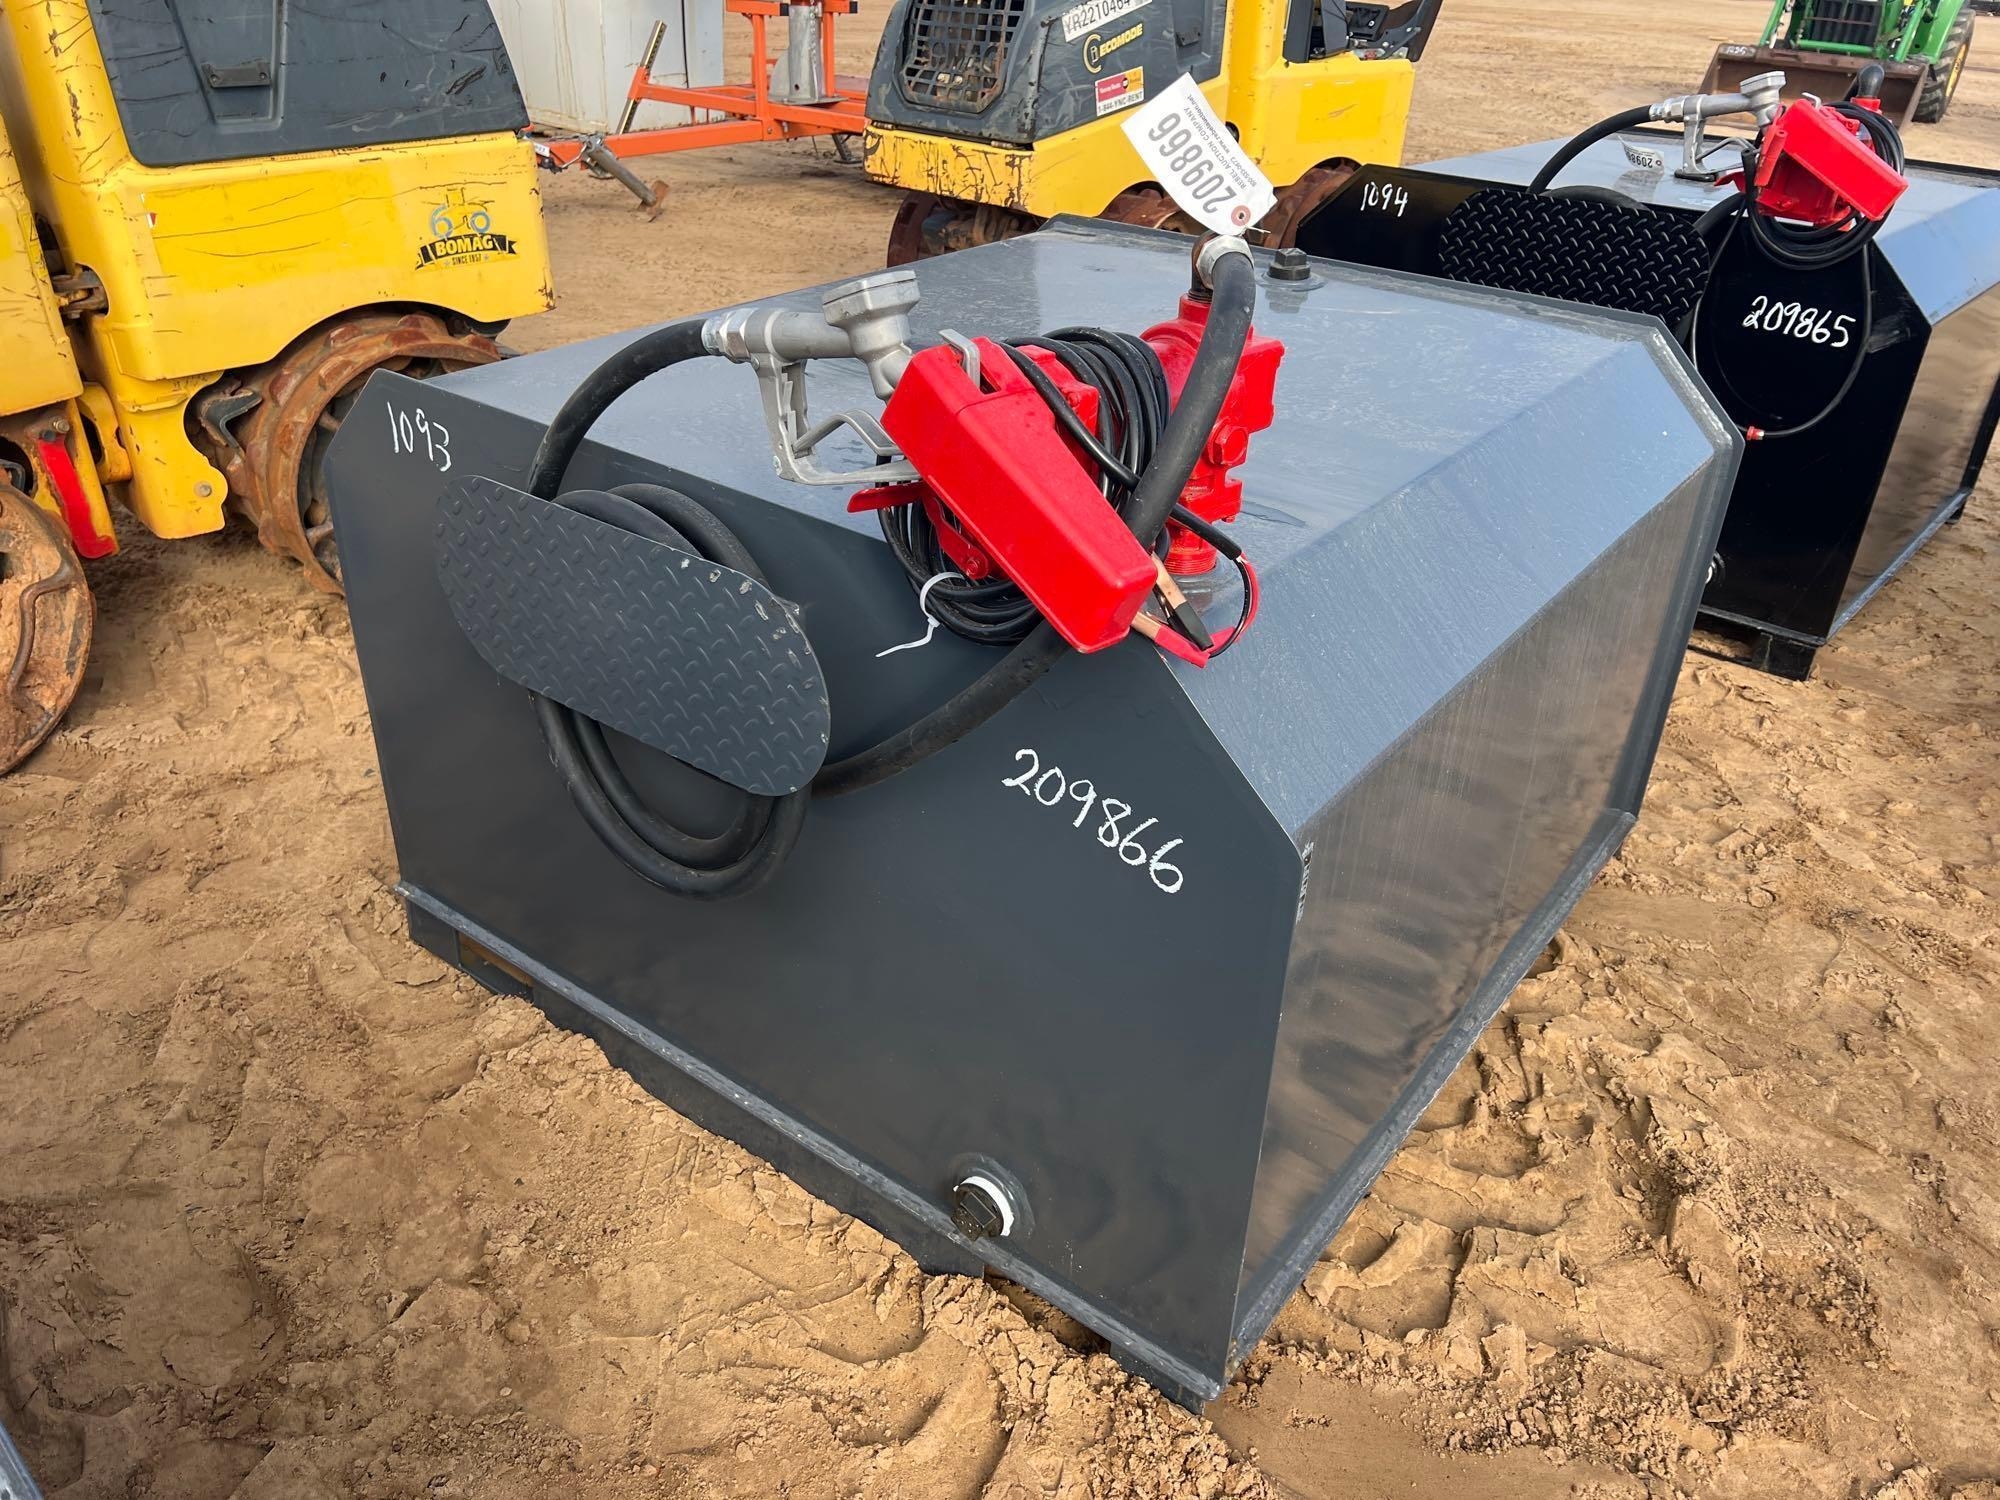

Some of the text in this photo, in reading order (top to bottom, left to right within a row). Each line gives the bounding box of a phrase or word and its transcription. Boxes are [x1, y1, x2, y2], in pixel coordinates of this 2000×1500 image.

[1098, 22, 1144, 58] ECOMODE
[1148, 112, 1238, 214] 209866
[1184, 107, 1247, 190] REBEL AUCTION COMPANY
[1360, 181, 1409, 217] 1094
[434, 235, 494, 257] BOMAG
[452, 254, 468, 266] SINCE
[1742, 295, 1857, 348] 209865
[386, 401, 452, 472] 1093
[1001, 748, 1184, 894] 209866
